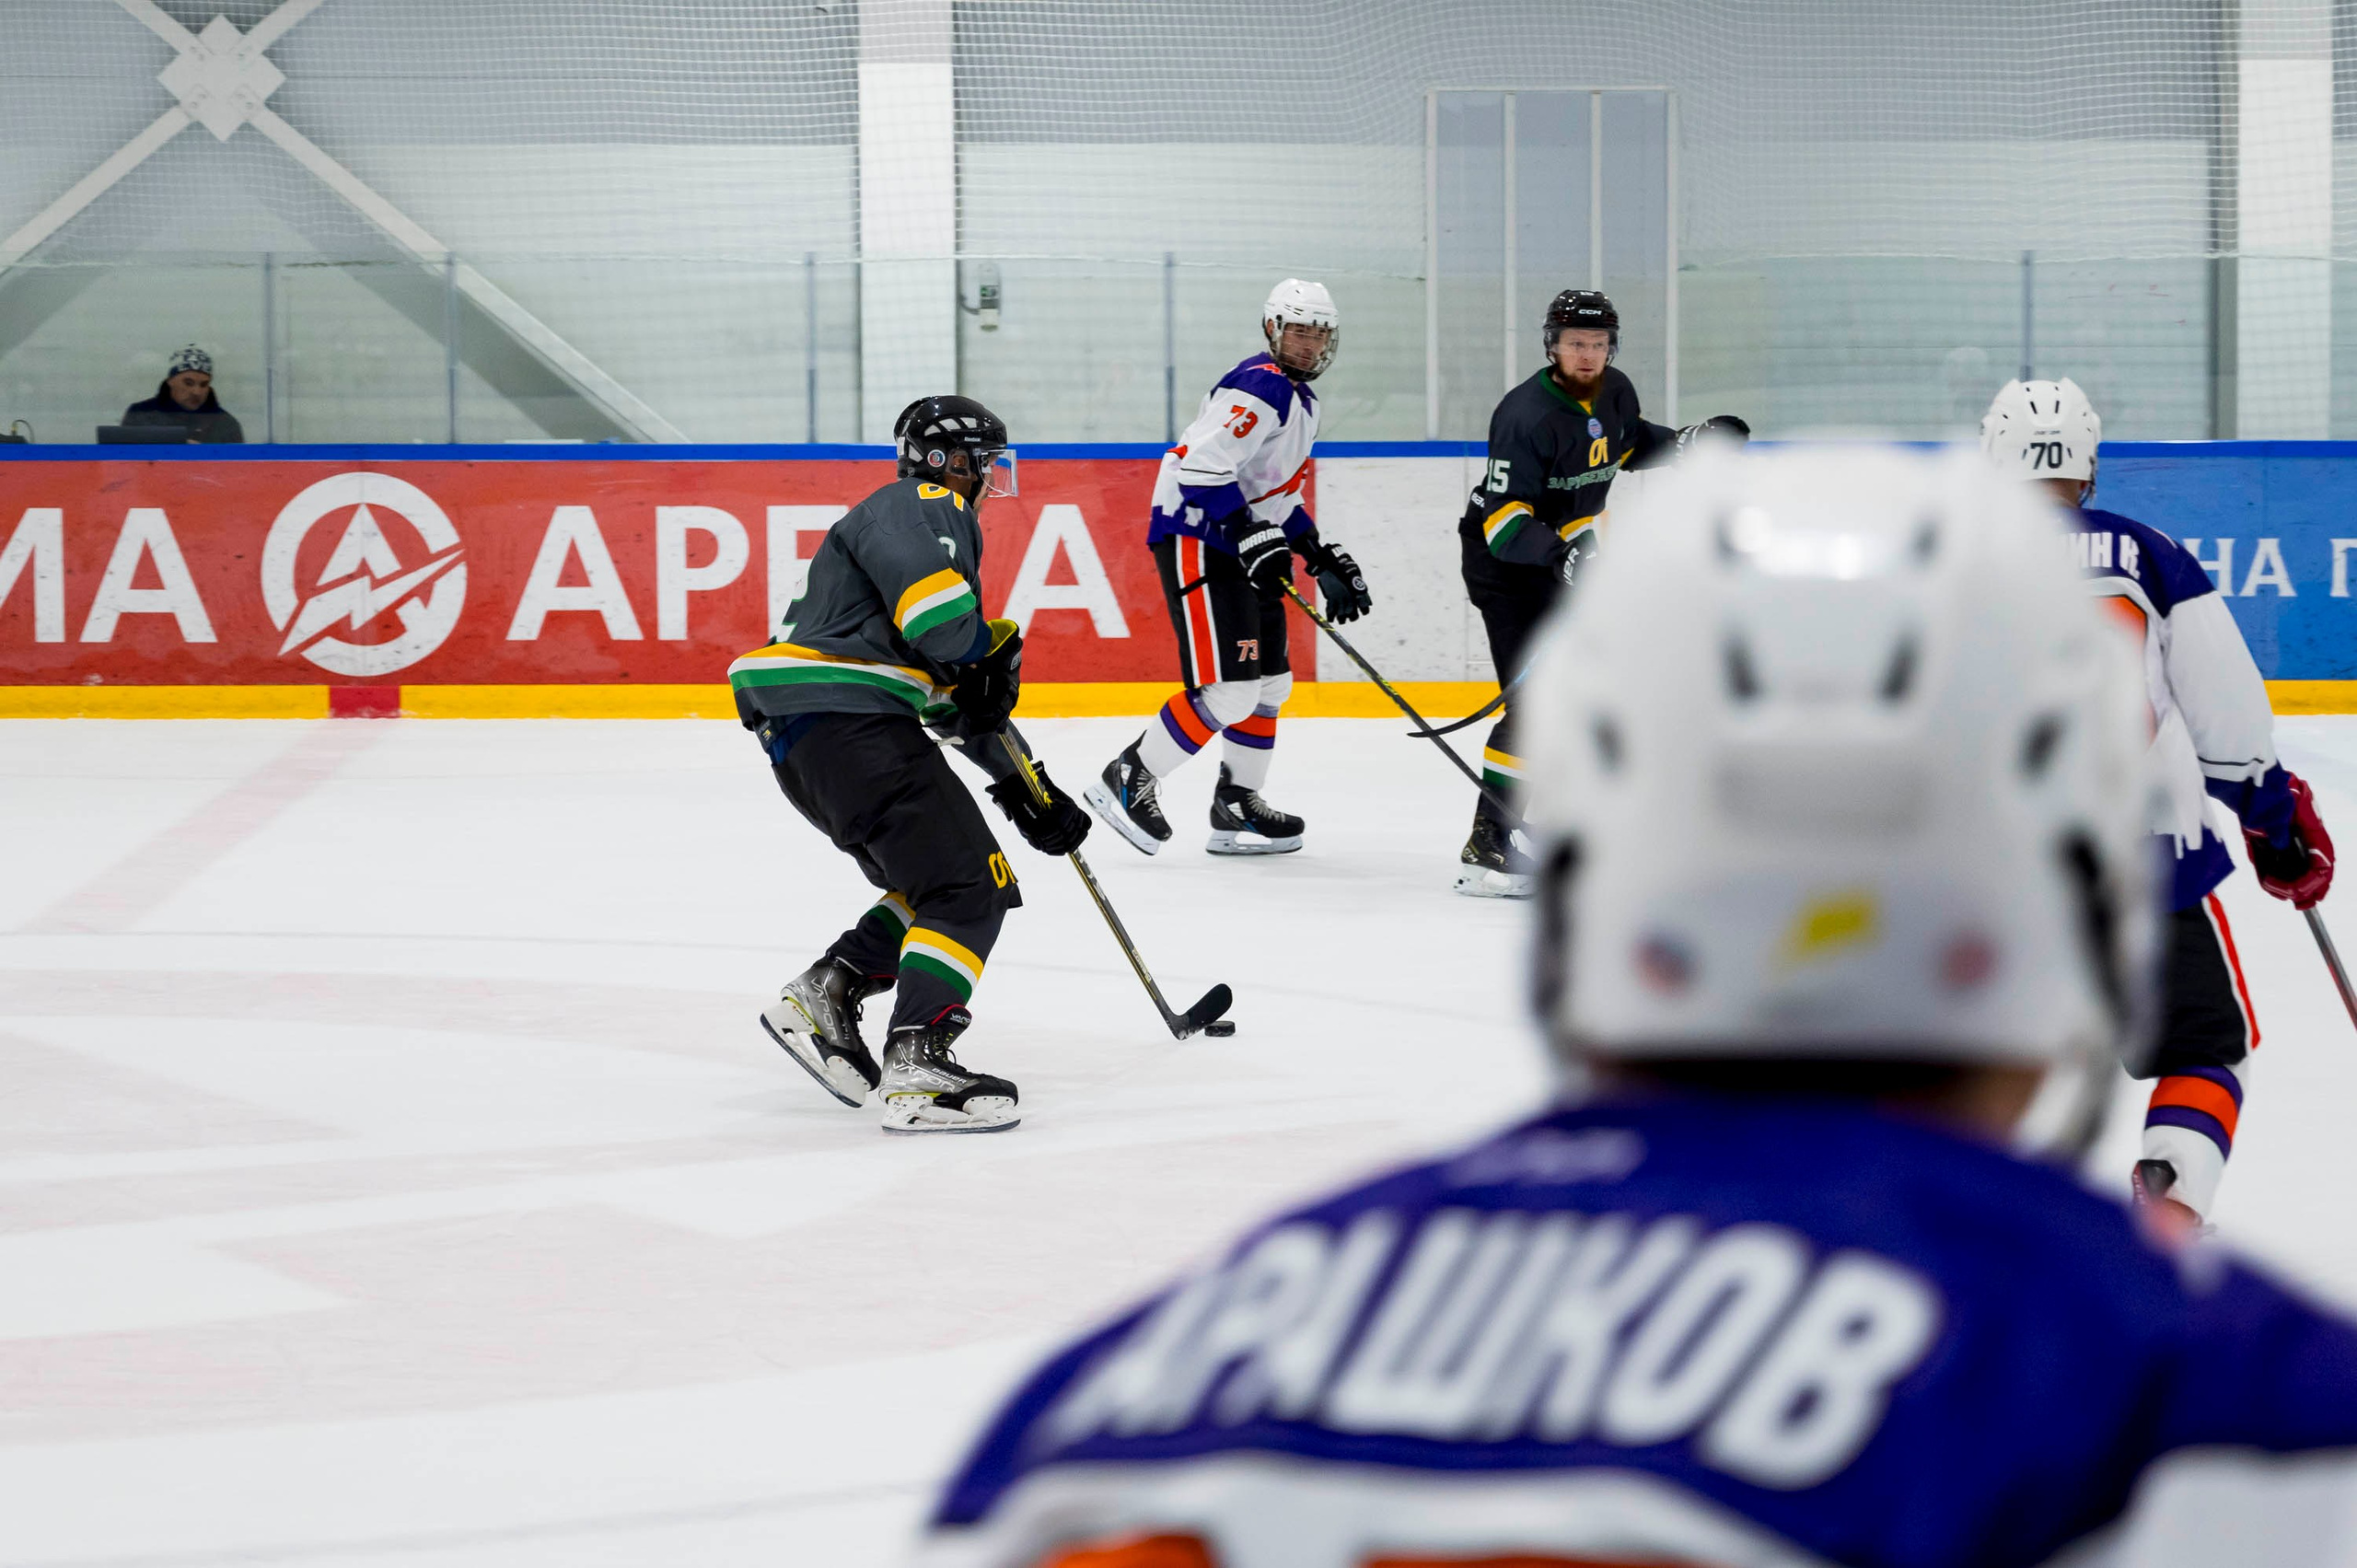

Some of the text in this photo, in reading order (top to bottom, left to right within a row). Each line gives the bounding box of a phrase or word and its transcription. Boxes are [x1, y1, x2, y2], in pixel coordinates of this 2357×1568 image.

[1223, 404, 1259, 439] 73
[2030, 441, 2063, 470] 70
[1487, 459, 1511, 494] 15
[505, 504, 1131, 642] АРЕА
[1237, 639, 1259, 662] 73
[951, 1013, 971, 1024] VAPO
[931, 1067, 968, 1085] BAUER
